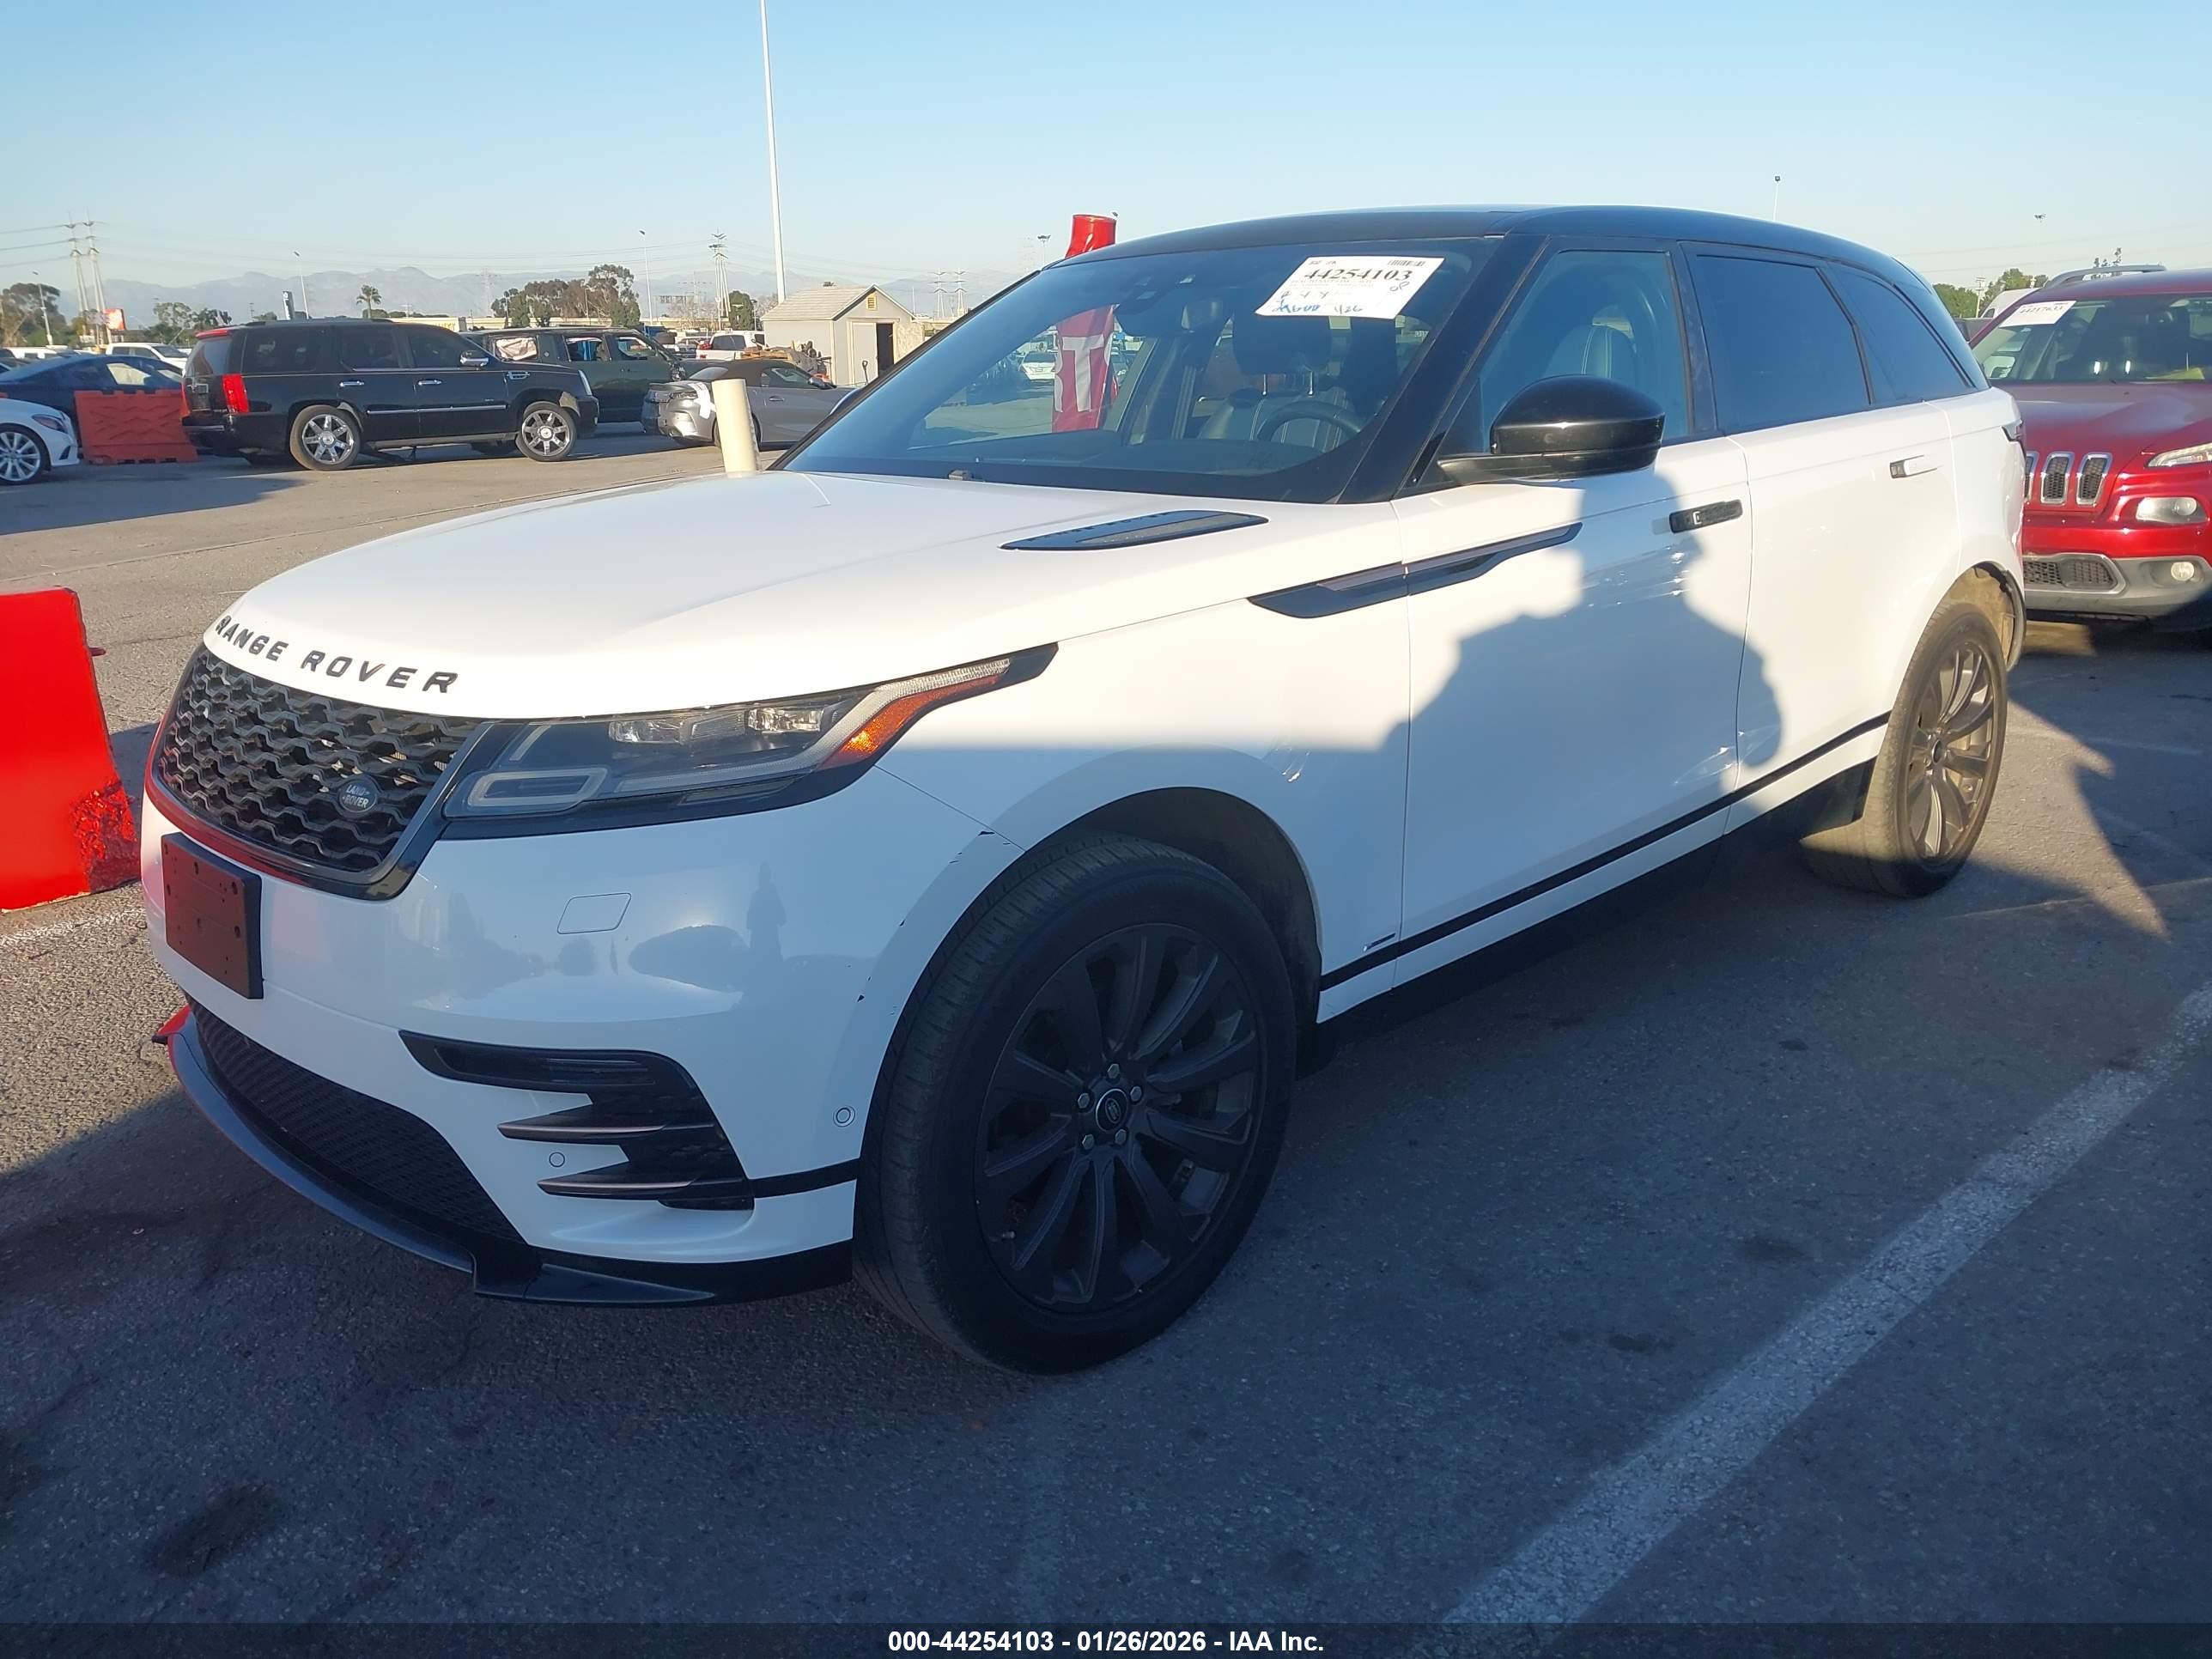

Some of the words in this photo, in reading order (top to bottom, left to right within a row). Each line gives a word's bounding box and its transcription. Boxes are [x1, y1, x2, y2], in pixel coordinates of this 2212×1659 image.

[1304, 269, 1413, 281] 44254103
[216, 615, 289, 662] RANGE
[301, 650, 458, 693] ROVER
[345, 796, 369, 808] ROVER
